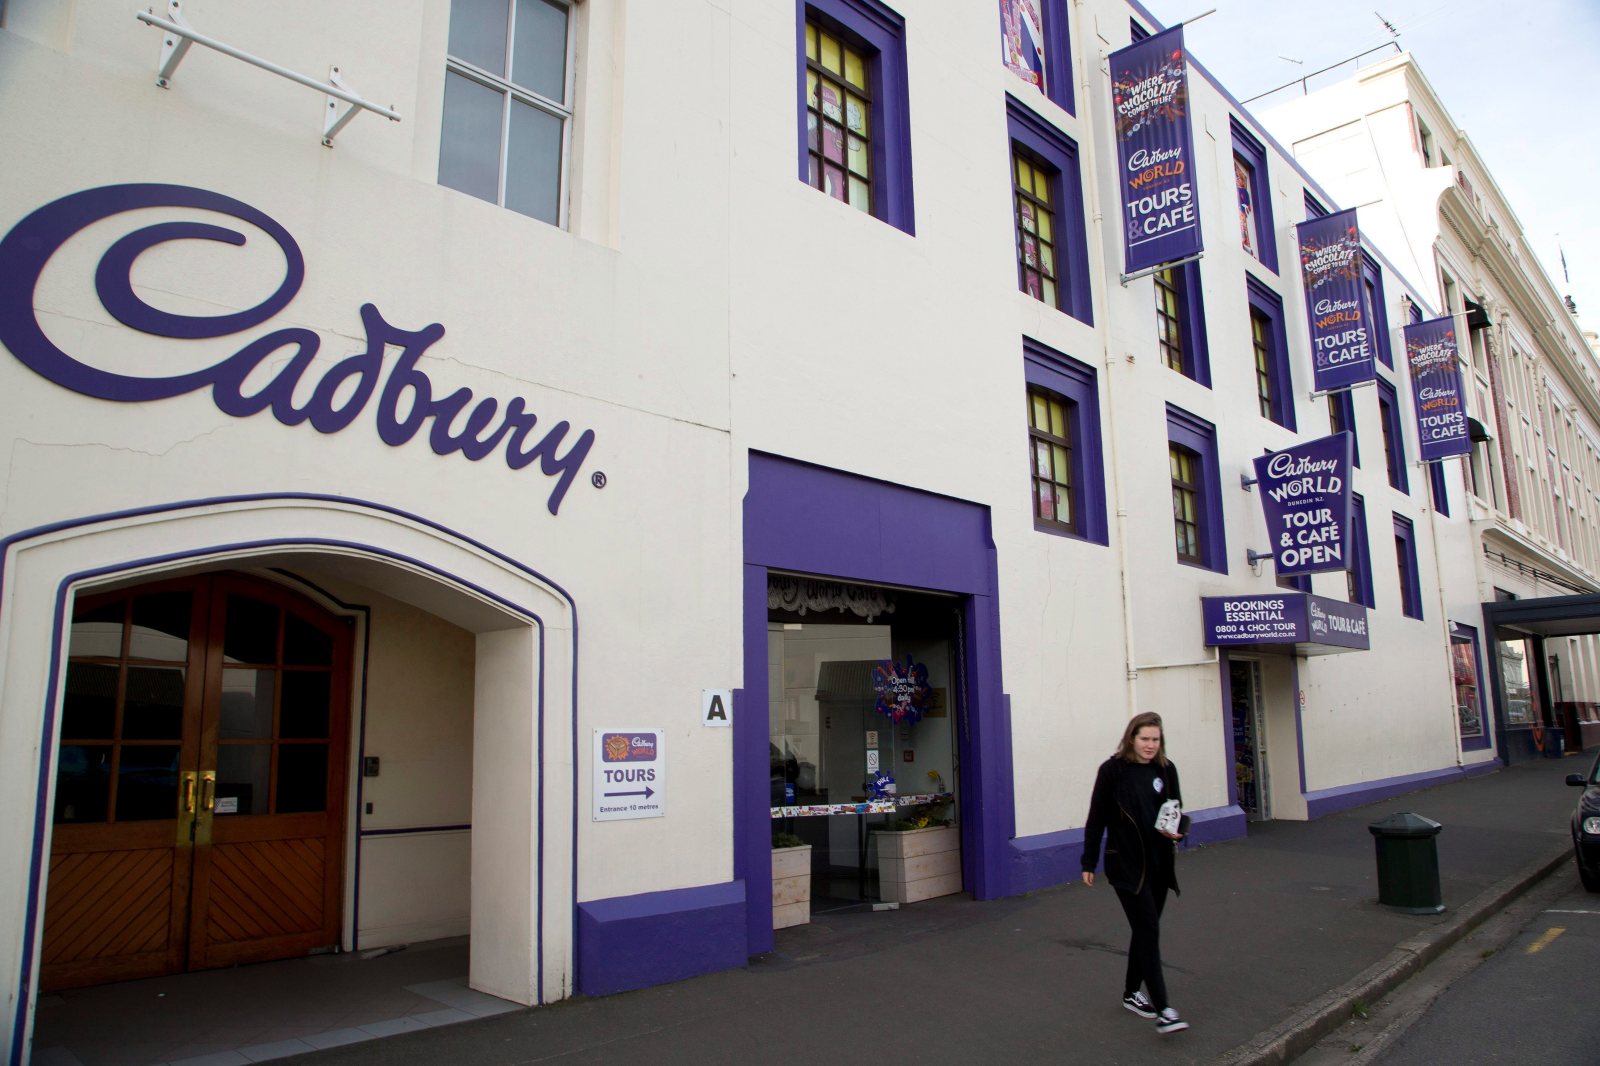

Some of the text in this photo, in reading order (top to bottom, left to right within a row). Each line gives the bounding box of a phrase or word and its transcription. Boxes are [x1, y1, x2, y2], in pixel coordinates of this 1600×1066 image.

[1131, 74, 1165, 96] WHERE
[1118, 80, 1181, 114] CHOCOLATE
[1128, 102, 1149, 117] COMES
[1160, 95, 1172, 104] LIFE
[1128, 147, 1181, 171] Cadbury
[1129, 161, 1184, 189] WORLD
[1127, 183, 1191, 218] TOURS
[1315, 244, 1343, 258] WHERE
[1305, 250, 1356, 272] CHOCOLATE
[1315, 299, 1358, 315] Cadbury
[1316, 310, 1361, 329] WORLD
[1315, 328, 1366, 350] TOURS
[0, 183, 594, 515] Cadbury
[1411, 349, 1454, 365] CHOCOLATE
[1419, 344, 1442, 354] WHERE
[1420, 387, 1456, 400] Cadbury
[1421, 398, 1458, 410] WORLD
[1420, 412, 1464, 427] TOURS
[1267, 453, 1337, 478] Cadbury
[1268, 476, 1341, 502] WORLD
[1288, 498, 1313, 506] DUNEDIN
[1283, 508, 1333, 528] TOUR
[1280, 522, 1340, 547] & CAFÉ
[1281, 542, 1341, 567] OPEN
[1224, 600, 1284, 612] BOOKINGS
[1311, 602, 1326, 620] Cadbury
[1226, 611, 1284, 622] ESSENTIAL
[1215, 625, 1237, 633] 0800
[1247, 624, 1271, 632] CHOC
[1217, 631, 1296, 639] www.cadburyworld.co.nz
[892, 676, 907, 686] Open
[897, 693, 911, 703] daily
[707, 695, 727, 720] A
[632, 737, 654, 748] Cadbury
[604, 768, 655, 783] TOURS
